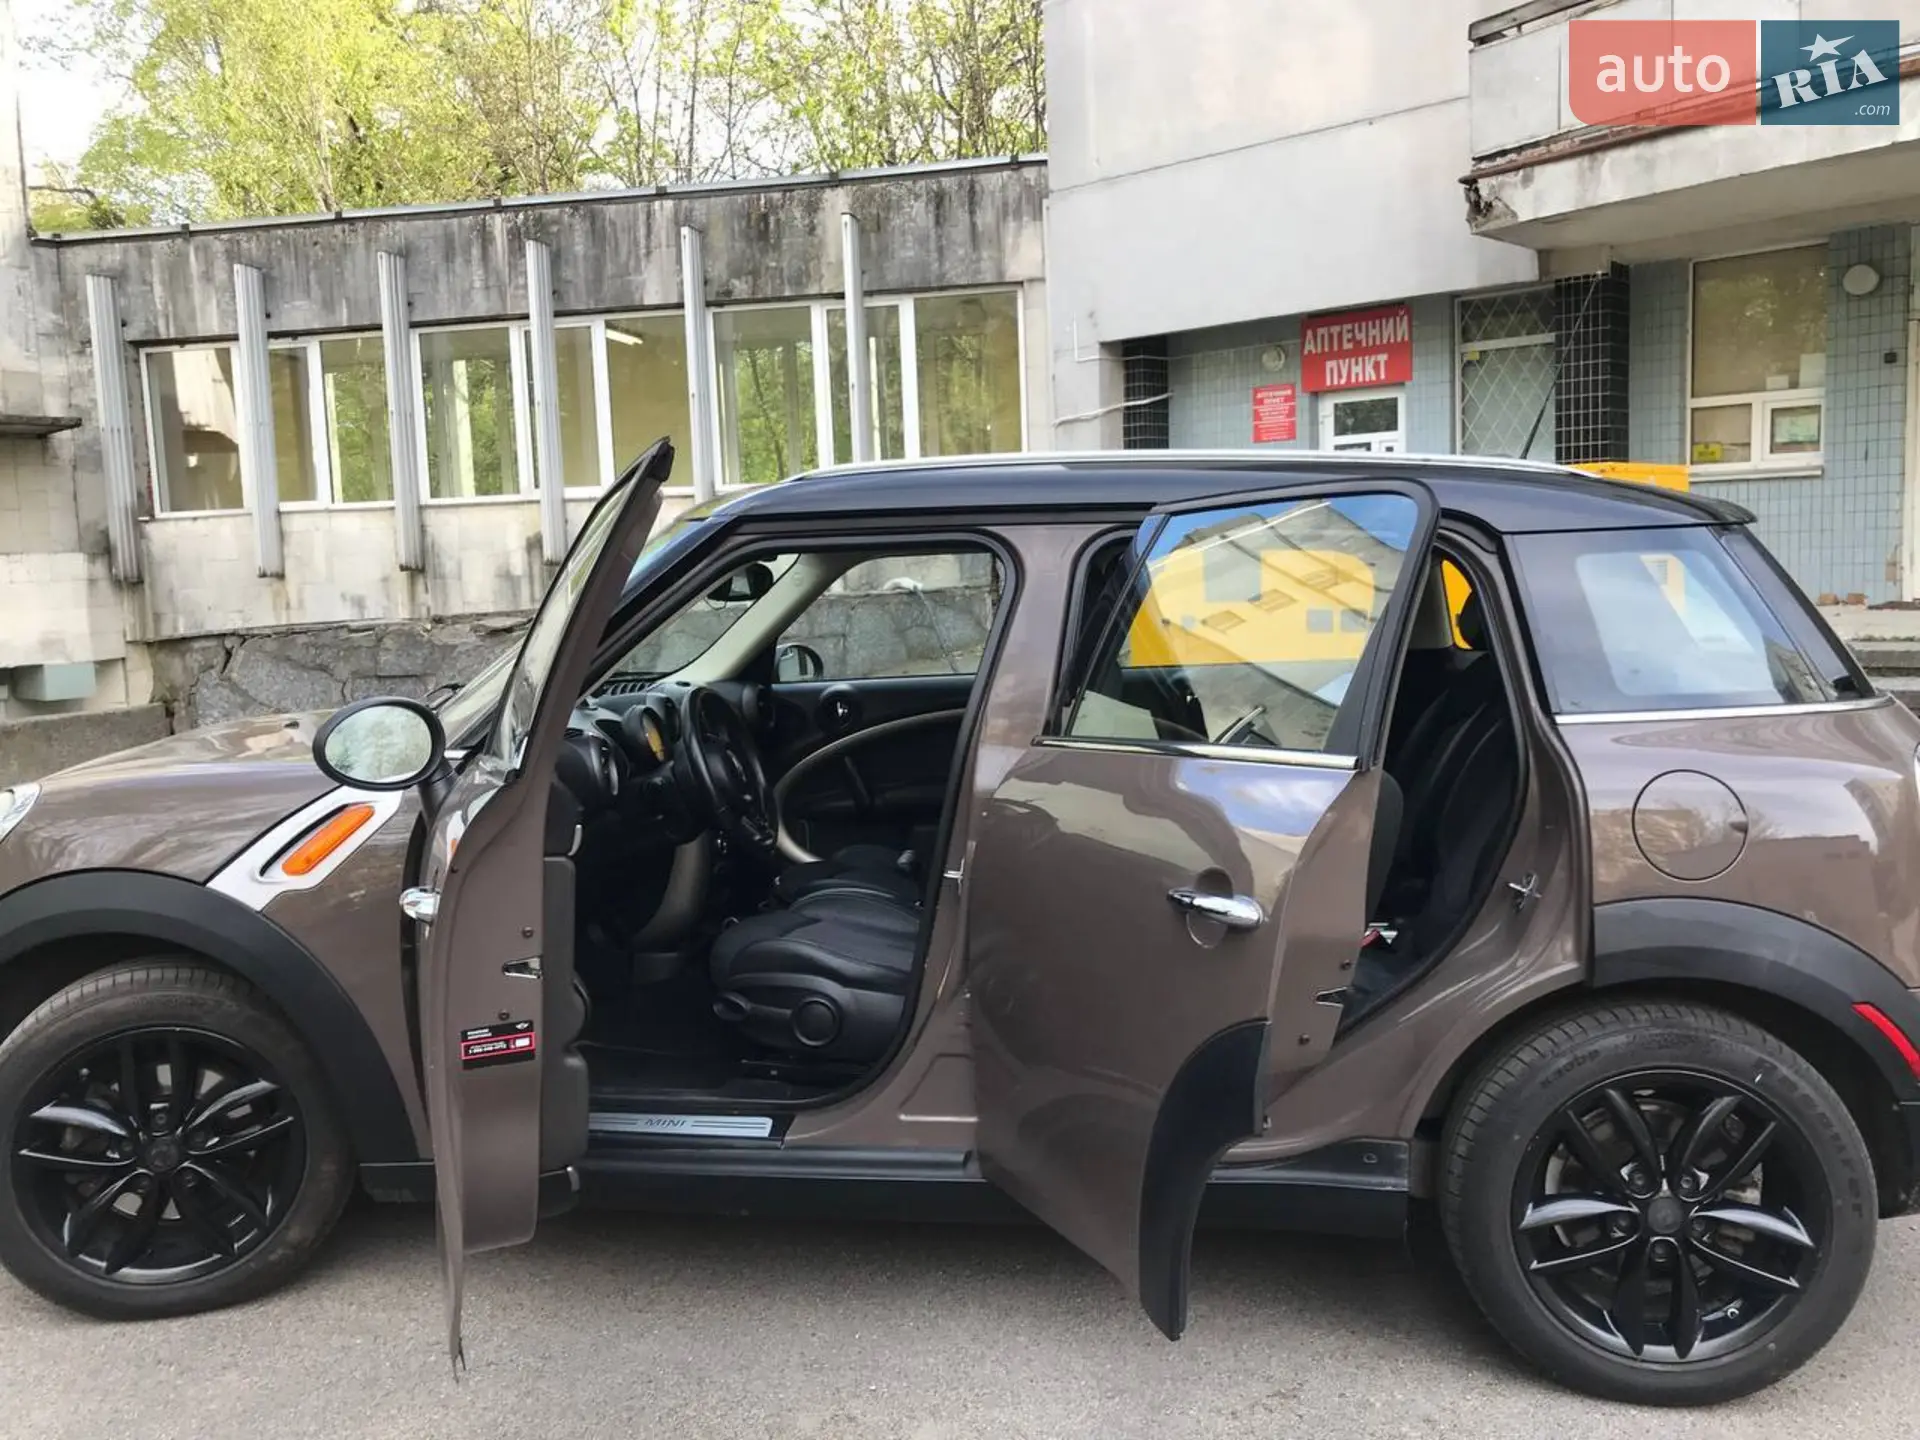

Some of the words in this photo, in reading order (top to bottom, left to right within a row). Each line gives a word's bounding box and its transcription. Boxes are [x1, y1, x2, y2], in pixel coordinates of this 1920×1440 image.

[1303, 310, 1409, 355] АПТЕЧНИЙ
[1325, 353, 1388, 386] ПУНКТ
[644, 1117, 687, 1128] MINI
